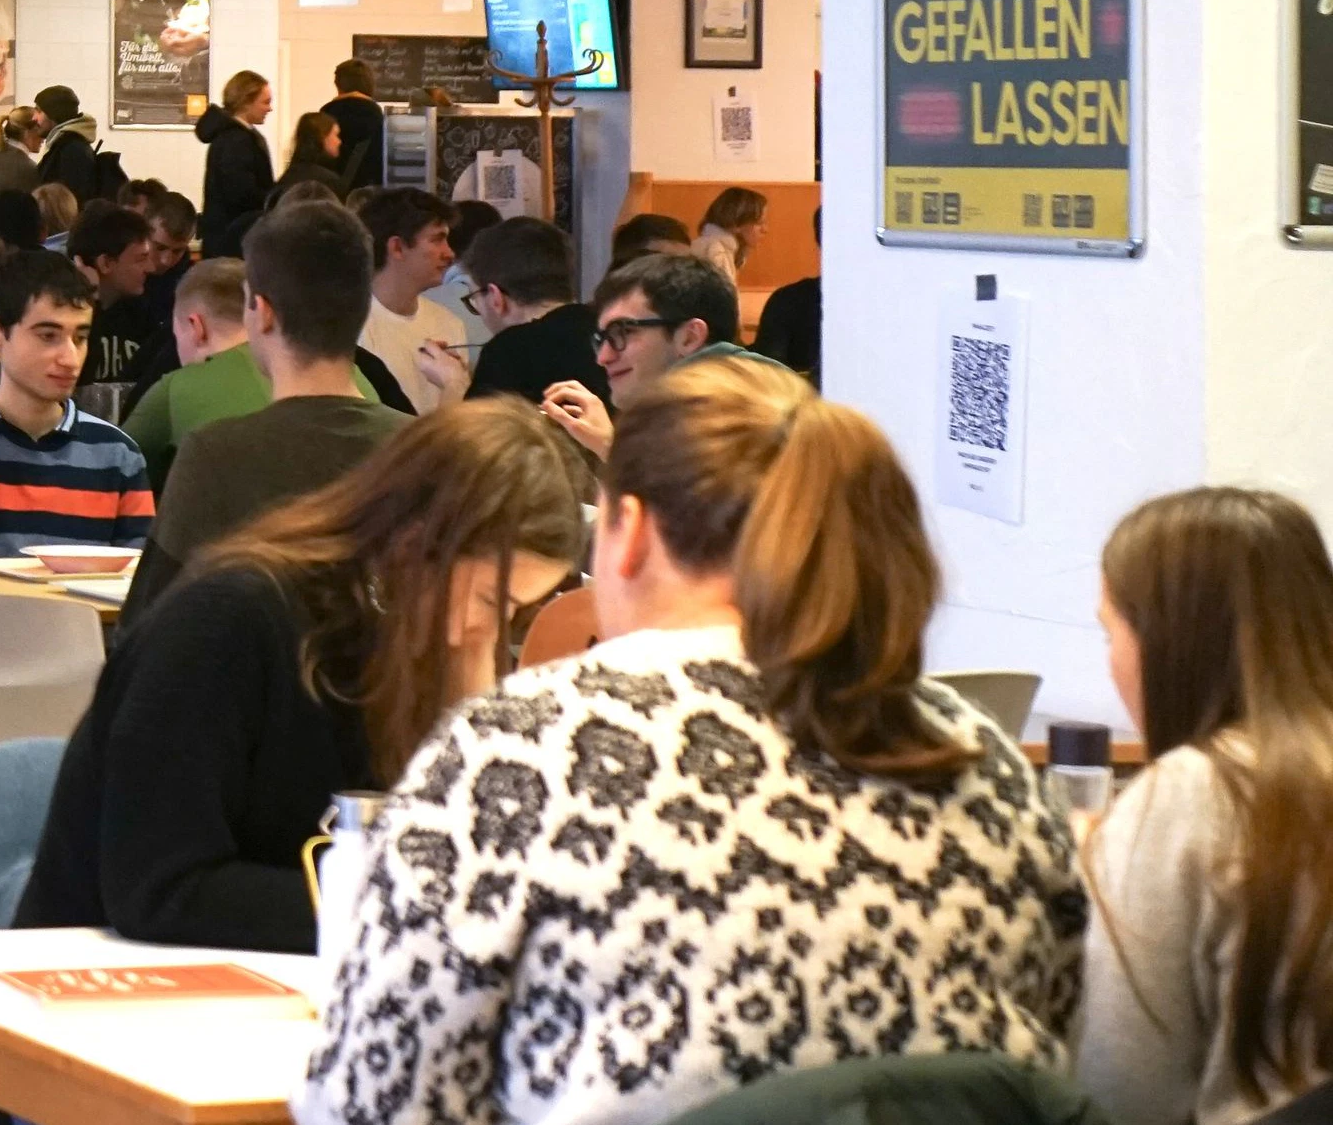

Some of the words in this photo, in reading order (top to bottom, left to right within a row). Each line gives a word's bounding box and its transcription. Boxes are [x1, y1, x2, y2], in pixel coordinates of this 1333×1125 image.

[120, 40, 140, 53] Für
[142, 41, 159, 53] die
[118, 61, 136, 75] für
[138, 64, 157, 73] uns
[971, 78, 1128, 146] LASSEN
